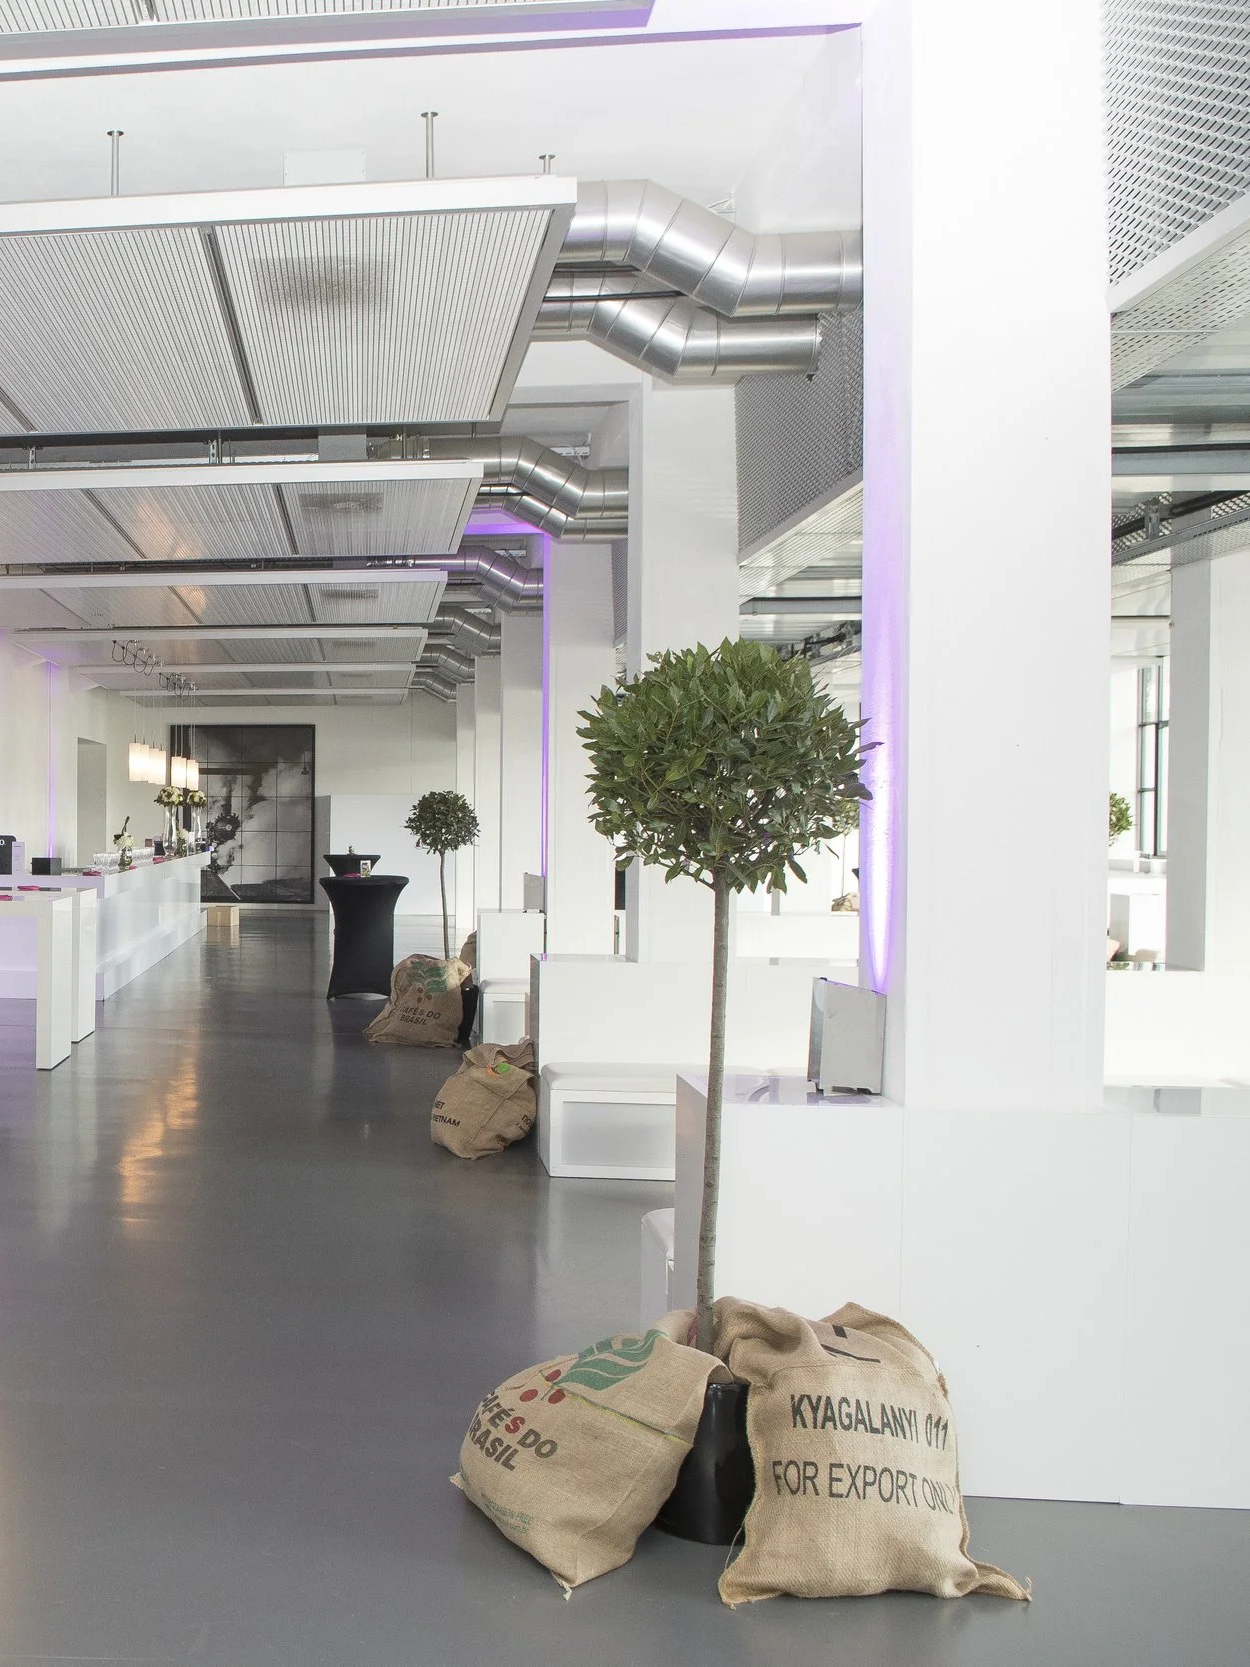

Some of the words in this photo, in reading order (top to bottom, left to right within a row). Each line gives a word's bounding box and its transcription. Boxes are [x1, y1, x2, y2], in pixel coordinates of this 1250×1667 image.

[426, 1011, 441, 1019] DO
[790, 1394, 918, 1443] KYAGALANYI
[925, 1413, 948, 1450] 011
[517, 1428, 558, 1458] DO
[772, 1460, 819, 1496] FOR
[828, 1463, 918, 1508] EXPORT
